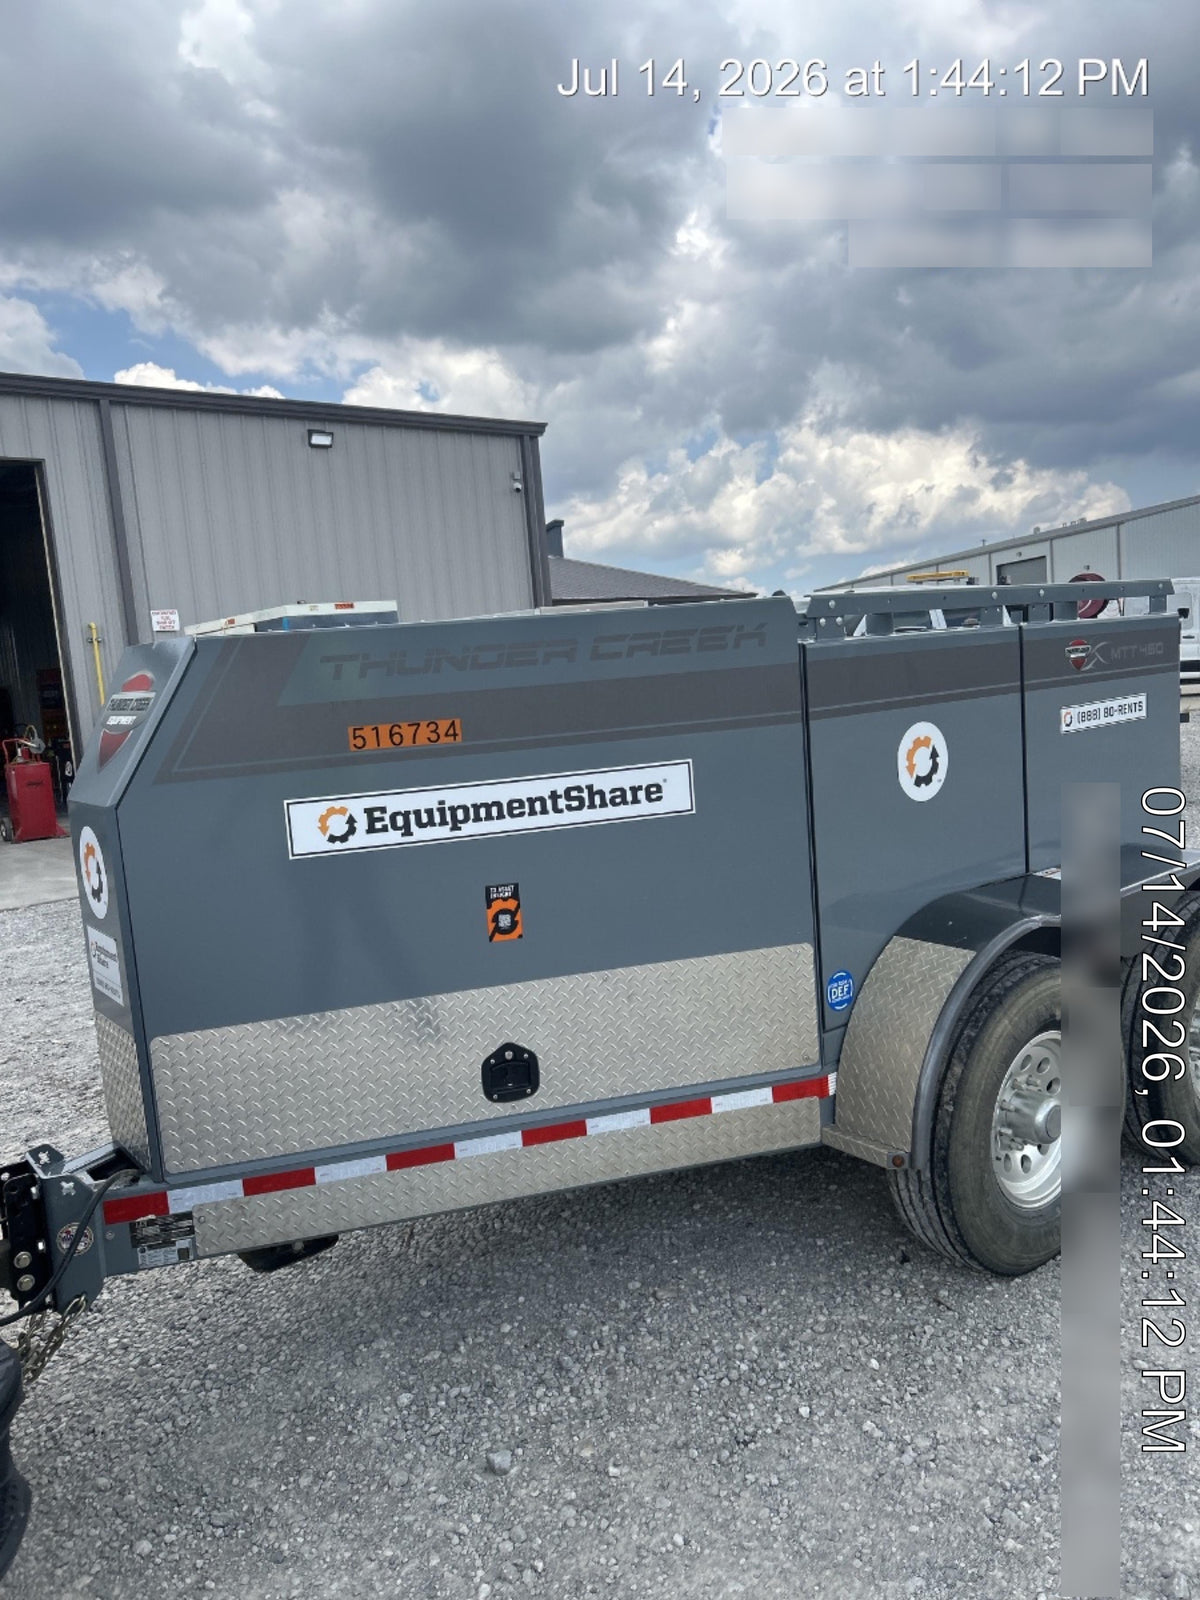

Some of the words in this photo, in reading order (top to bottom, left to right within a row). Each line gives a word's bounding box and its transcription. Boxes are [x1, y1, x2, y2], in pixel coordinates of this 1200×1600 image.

[319, 639, 578, 681] THUNDER
[589, 622, 768, 662] CREEK
[1077, 708, 1101, 724] (888)
[1103, 701, 1144, 718] 80-RENTS
[352, 719, 459, 750] 516734
[363, 781, 664, 837] EquipmentShare
[831, 983, 850, 1000] DEF
